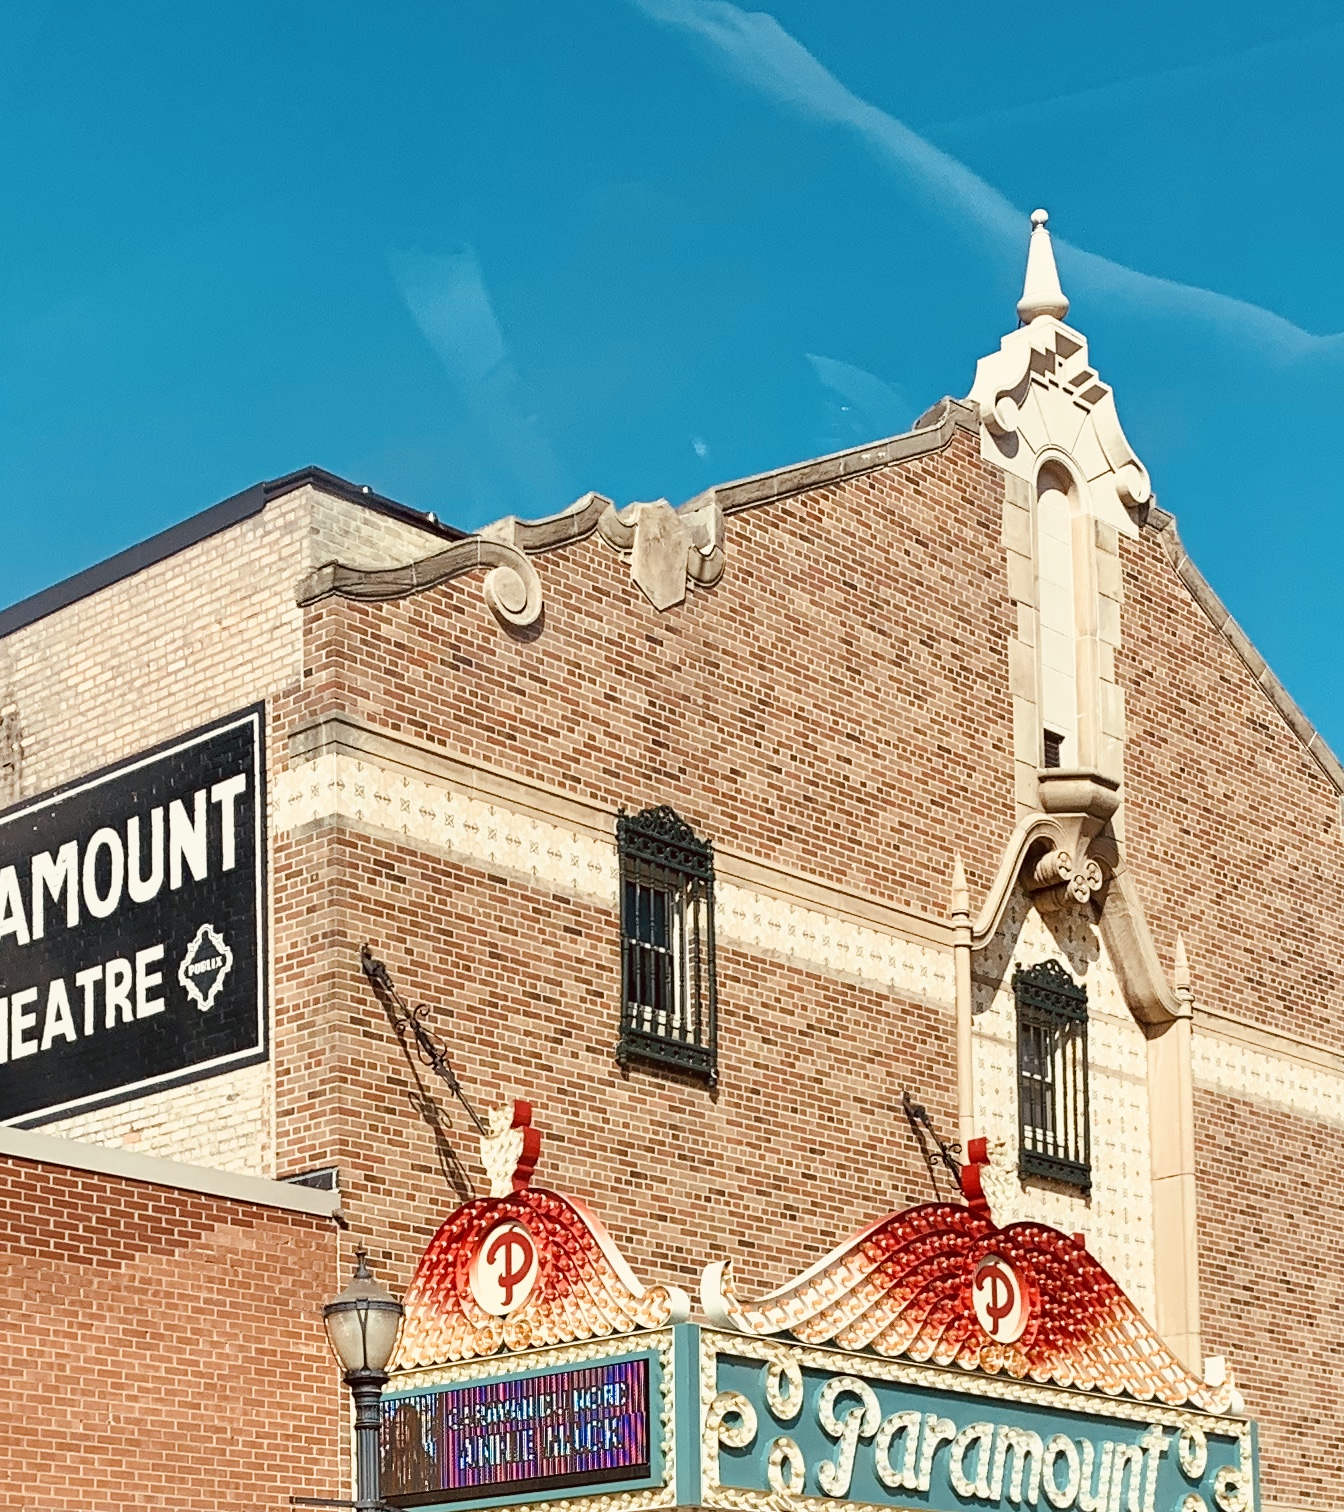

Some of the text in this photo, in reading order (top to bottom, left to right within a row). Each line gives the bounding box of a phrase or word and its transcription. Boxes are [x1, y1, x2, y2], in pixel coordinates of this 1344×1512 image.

[187, 955, 223, 977] PUBLIX
[486, 1229, 534, 1306] P
[975, 1263, 1015, 1335] P
